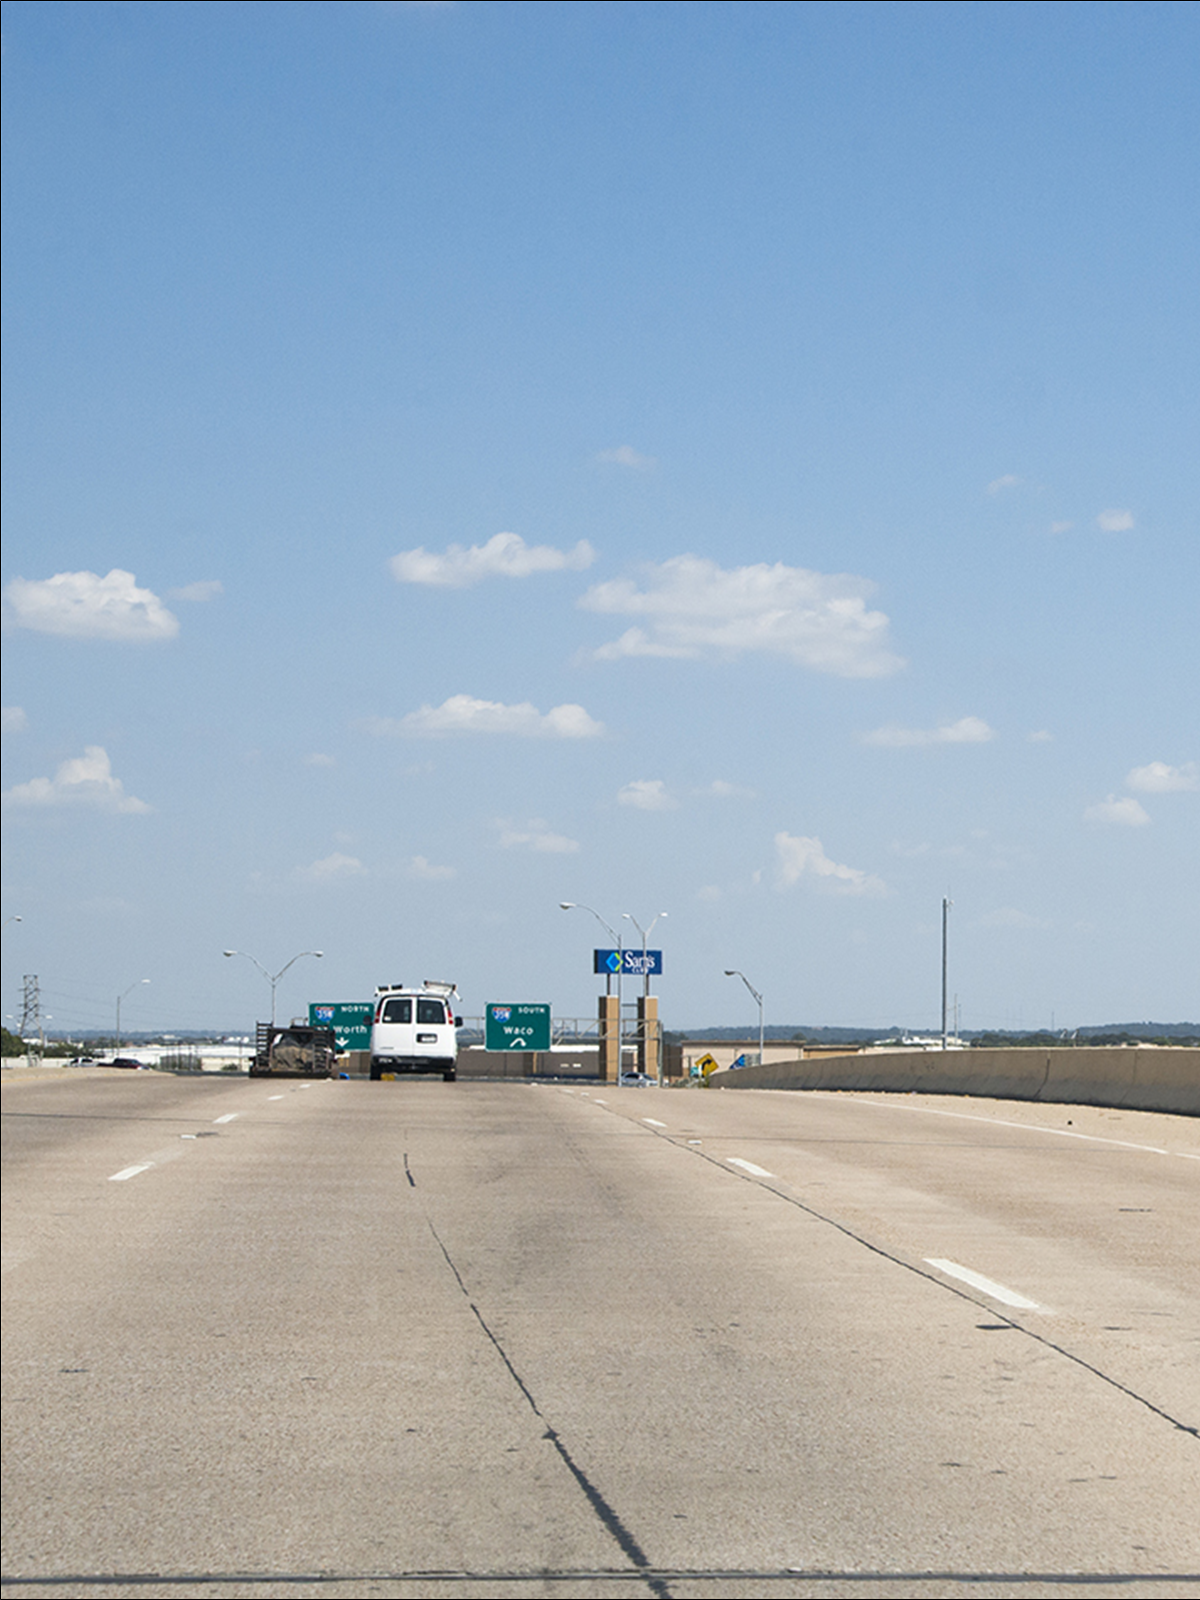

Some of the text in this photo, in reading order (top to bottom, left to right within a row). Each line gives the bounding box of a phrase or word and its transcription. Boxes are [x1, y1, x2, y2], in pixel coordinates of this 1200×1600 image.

[518, 1006, 546, 1014] SOUTH
[333, 1025, 368, 1034] Worth
[502, 1026, 534, 1036] Waco
